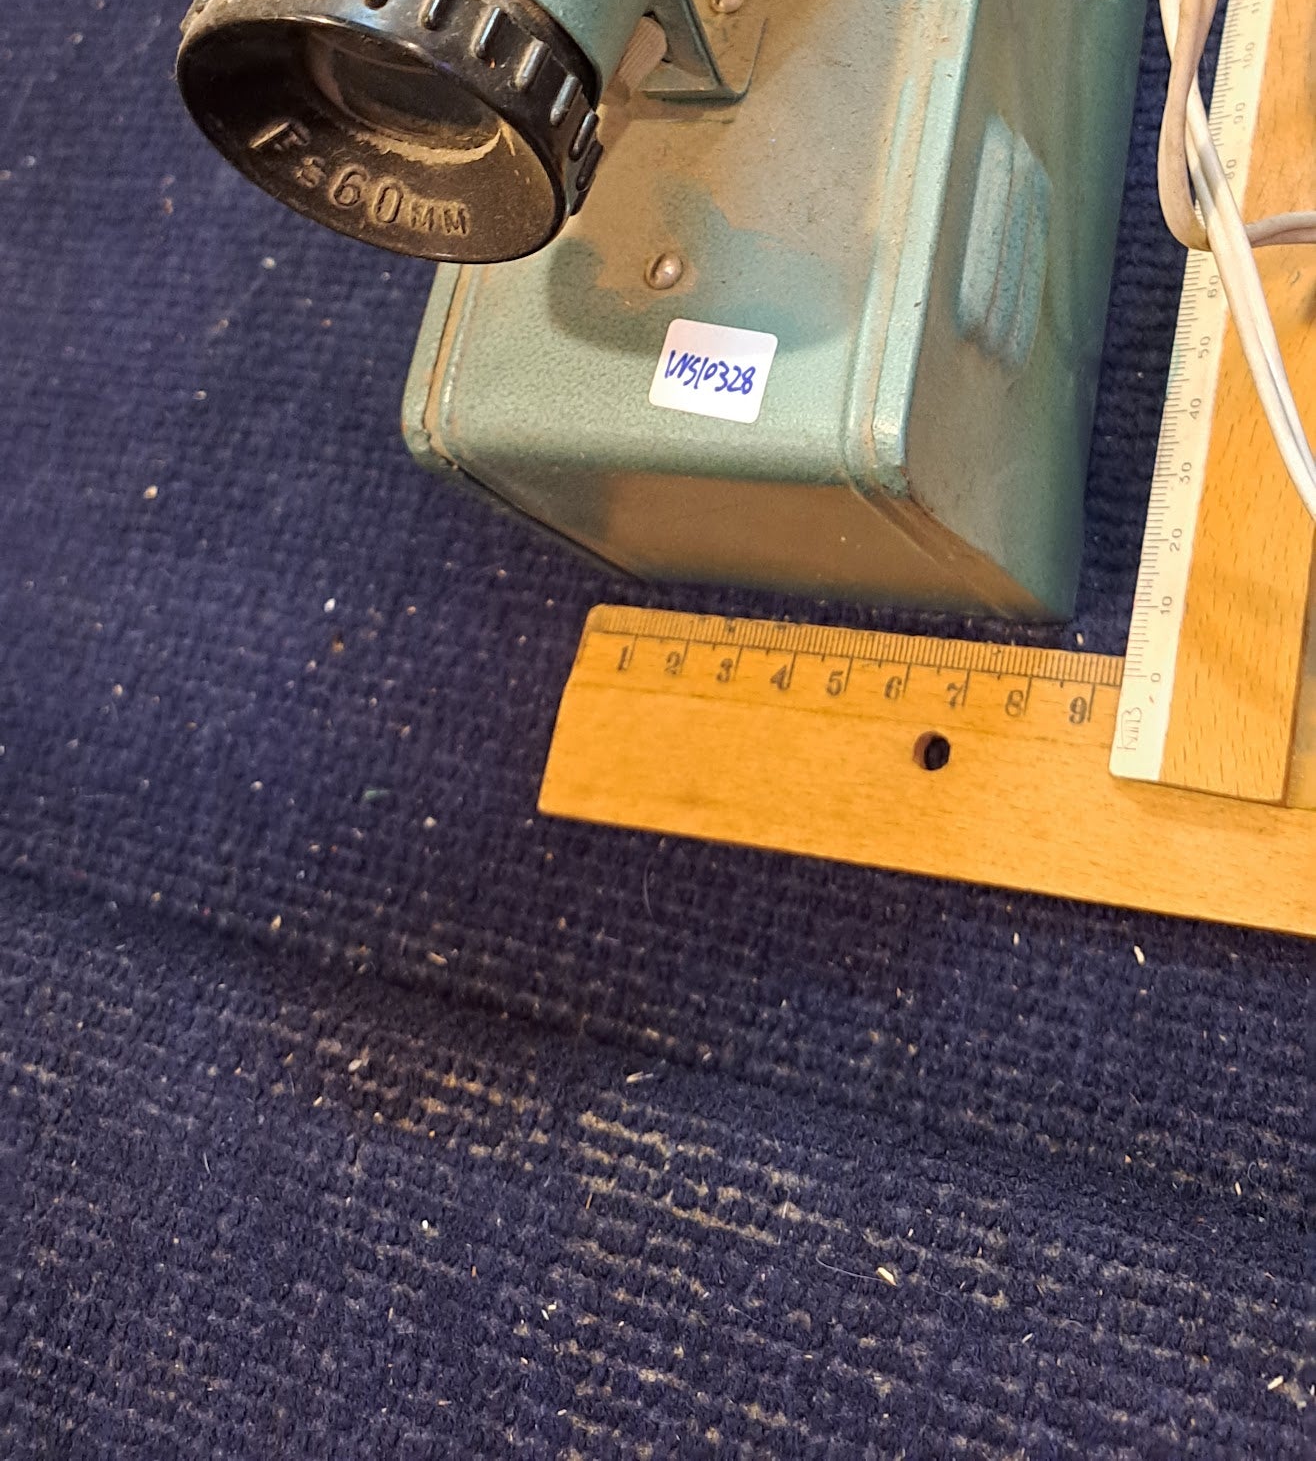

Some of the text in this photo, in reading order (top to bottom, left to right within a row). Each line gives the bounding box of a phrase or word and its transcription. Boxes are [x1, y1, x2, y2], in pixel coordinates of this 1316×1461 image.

[1150, 672, 1161, 683] 0
[1160, 595, 1173, 615] 10
[1169, 527, 1183, 553] 20
[1179, 461, 1192, 485] 30
[1189, 397, 1202, 420] 40
[1198, 336, 1211, 359] 50
[1207, 274, 1220, 299] 60
[1242, 41, 1255, 69] 100
[617, 645, 1088, 725] 1 2 3 4 5 6 7 8 9
